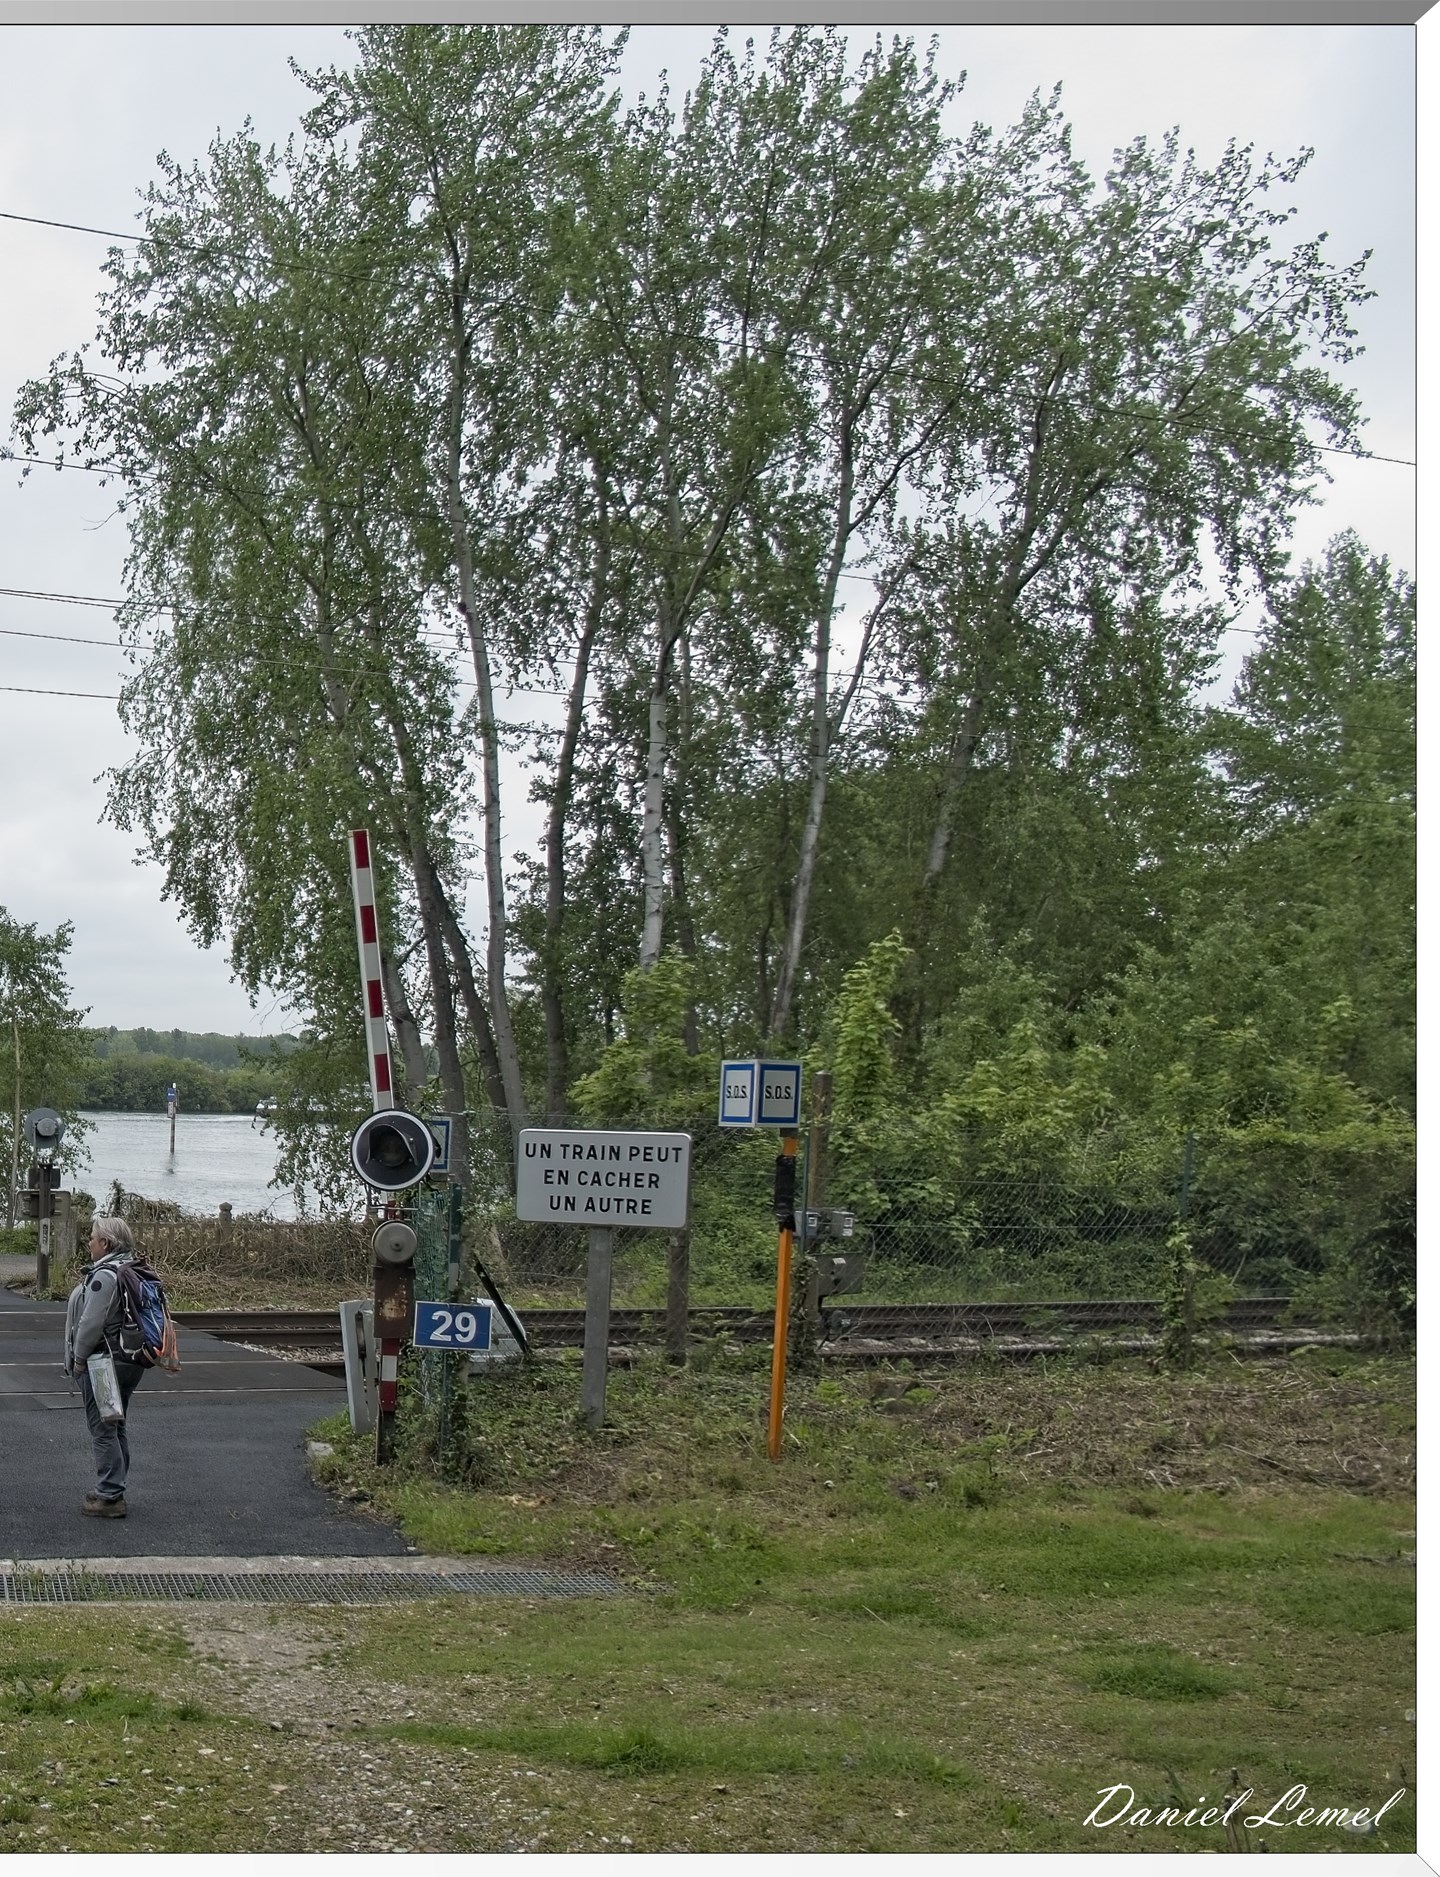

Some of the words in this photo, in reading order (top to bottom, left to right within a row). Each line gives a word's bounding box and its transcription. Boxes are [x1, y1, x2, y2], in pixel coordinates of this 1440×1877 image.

[764, 1085, 794, 1100] S.O.S.
[525, 1143, 552, 1159] UN
[560, 1143, 621, 1161] TRAIN
[628, 1146, 683, 1163] PEUT
[543, 1169, 569, 1186] EN
[577, 1170, 660, 1189] CACHER
[549, 1195, 576, 1211] UN
[584, 1196, 652, 1215] AUTRE
[429, 1310, 477, 1343] 29
